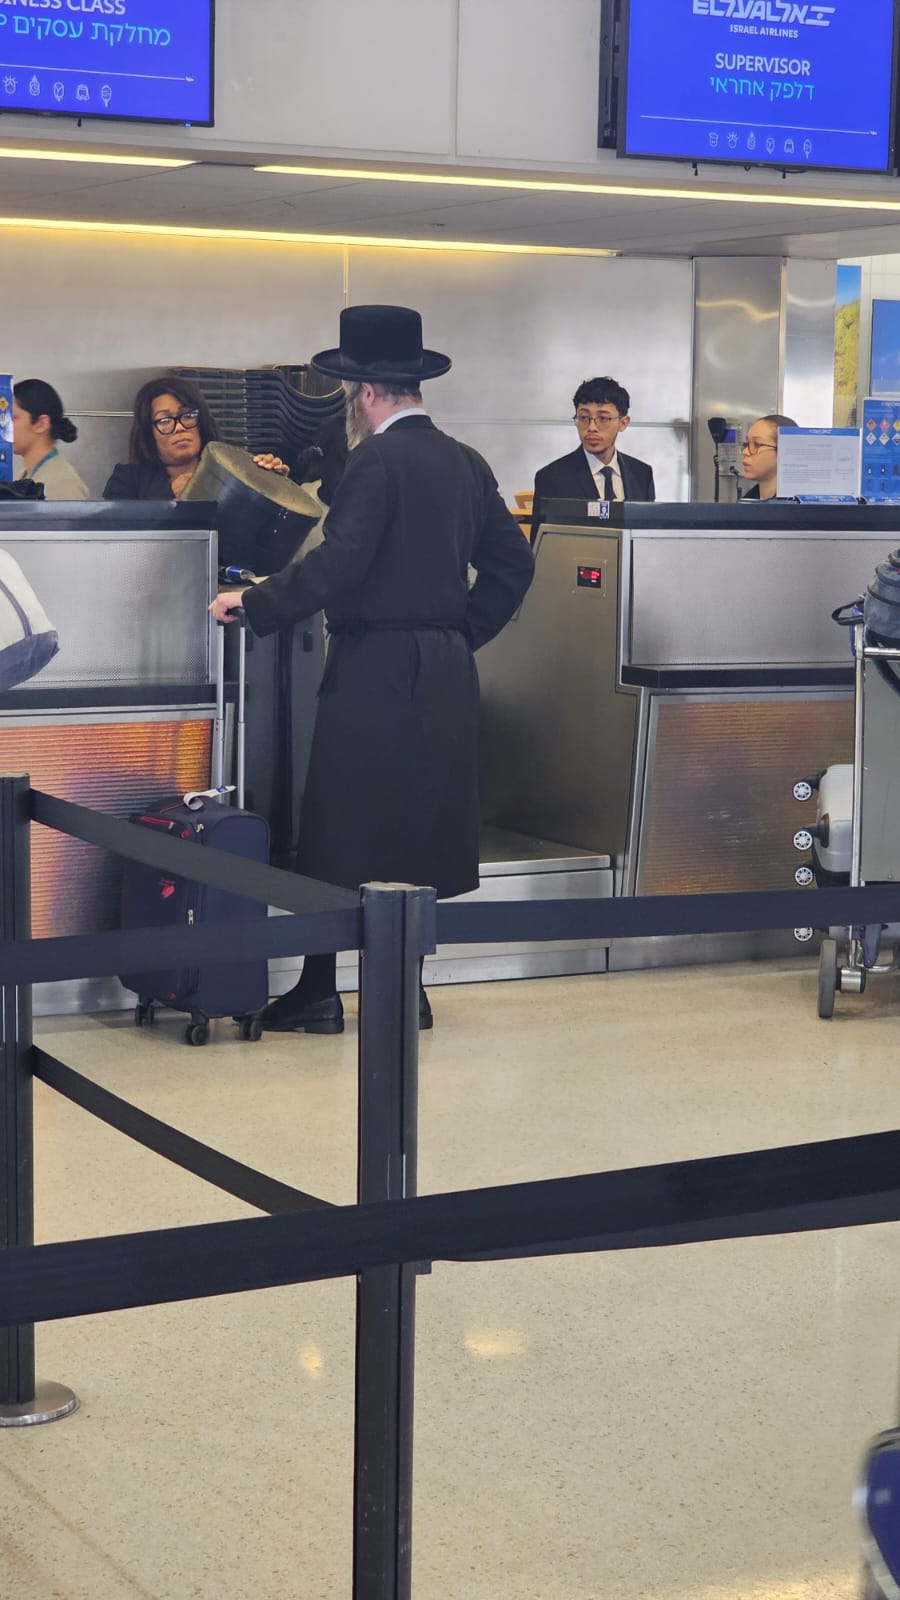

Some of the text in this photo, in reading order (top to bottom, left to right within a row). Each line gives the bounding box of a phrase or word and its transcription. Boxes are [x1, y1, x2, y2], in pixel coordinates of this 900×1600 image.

[67, 0, 126, 15] CLASS
[13, 15, 83, 41] עסקים
[91, 22, 171, 47] מחלקת
[730, 23, 799, 39] ISRAEL AIRLINES
[715, 52, 811, 76] SUPERVISOR
[709, 76, 815, 102] דלפק אחראי
